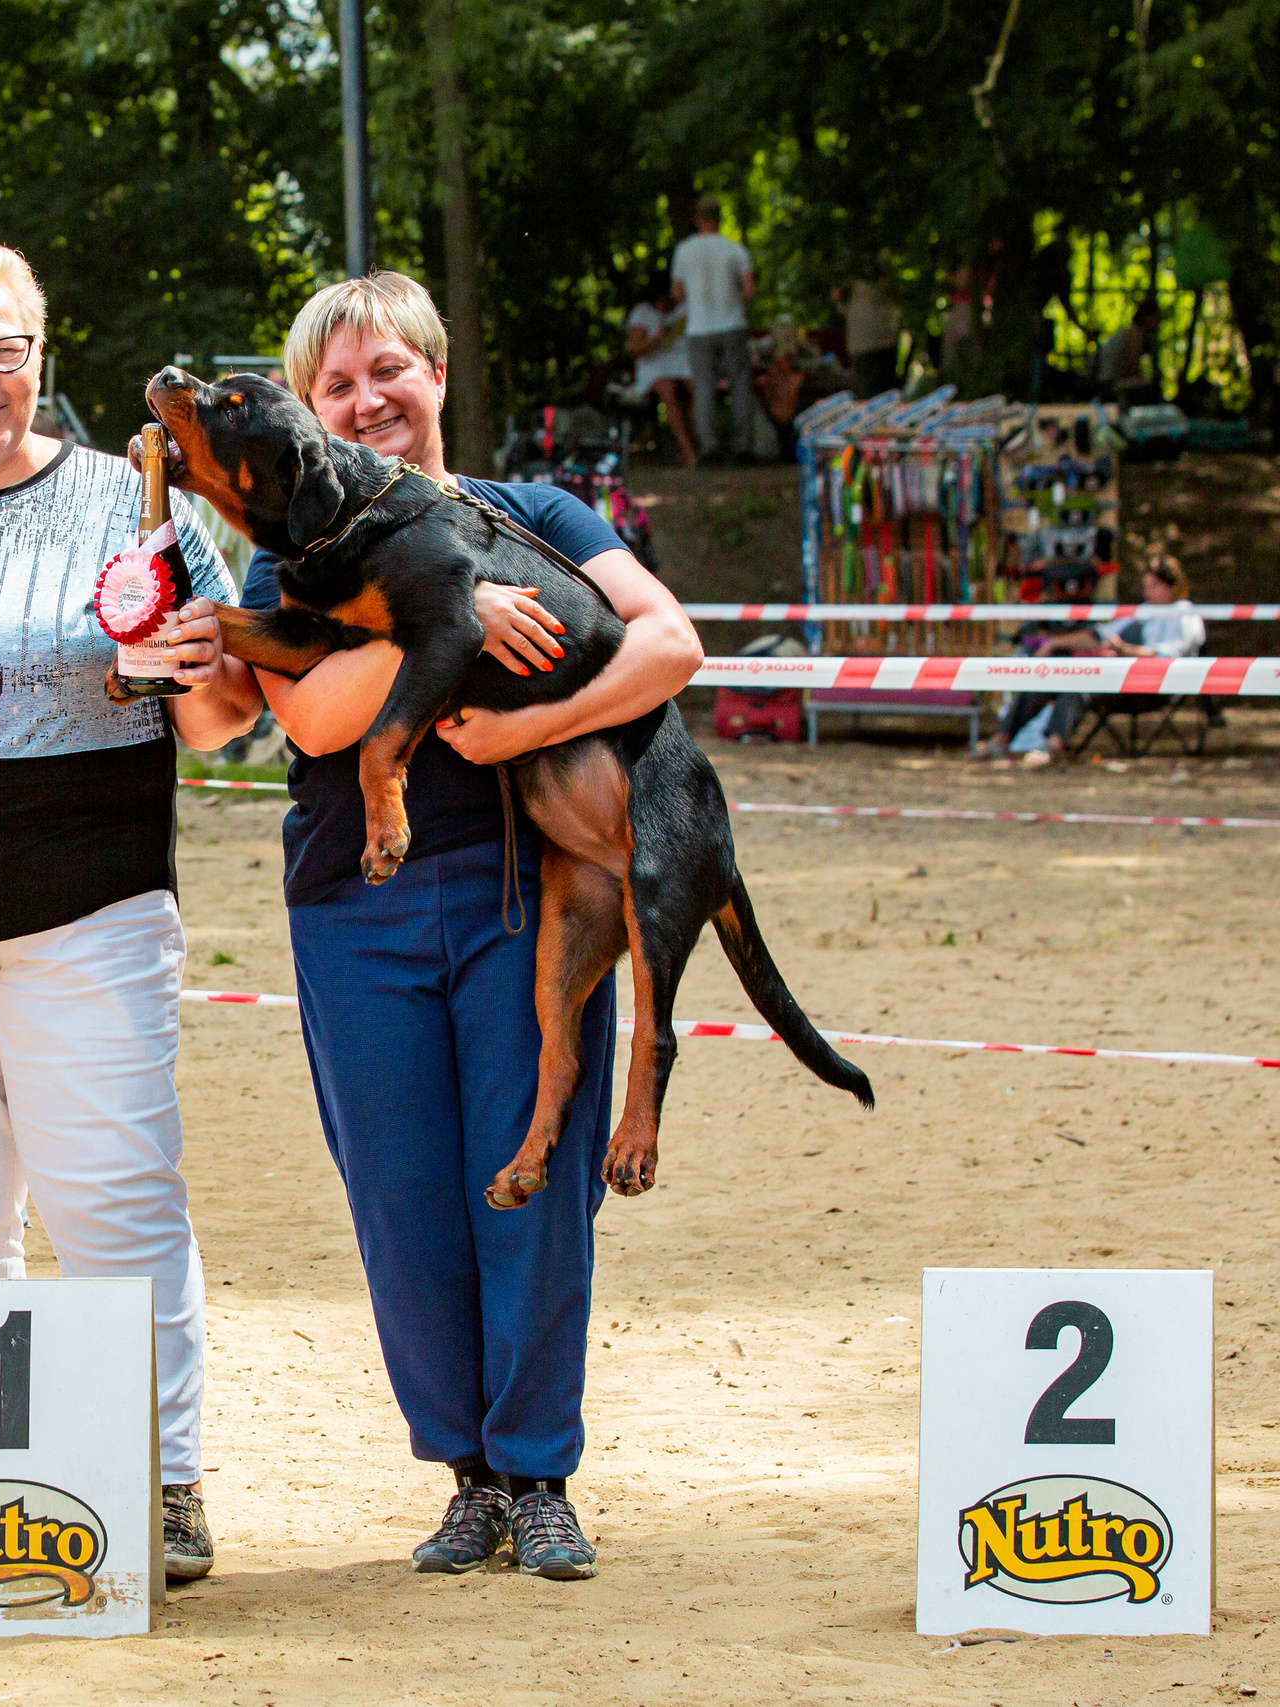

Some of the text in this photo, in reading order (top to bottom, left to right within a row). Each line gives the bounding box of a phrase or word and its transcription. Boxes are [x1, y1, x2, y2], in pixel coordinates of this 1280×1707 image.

[766, 663, 814, 673] ВОСТОК
[986, 665, 1101, 676] ВОСТОК СЕРВИС
[1024, 1300, 1116, 1445] 2
[959, 1492, 1164, 1598] Nutro
